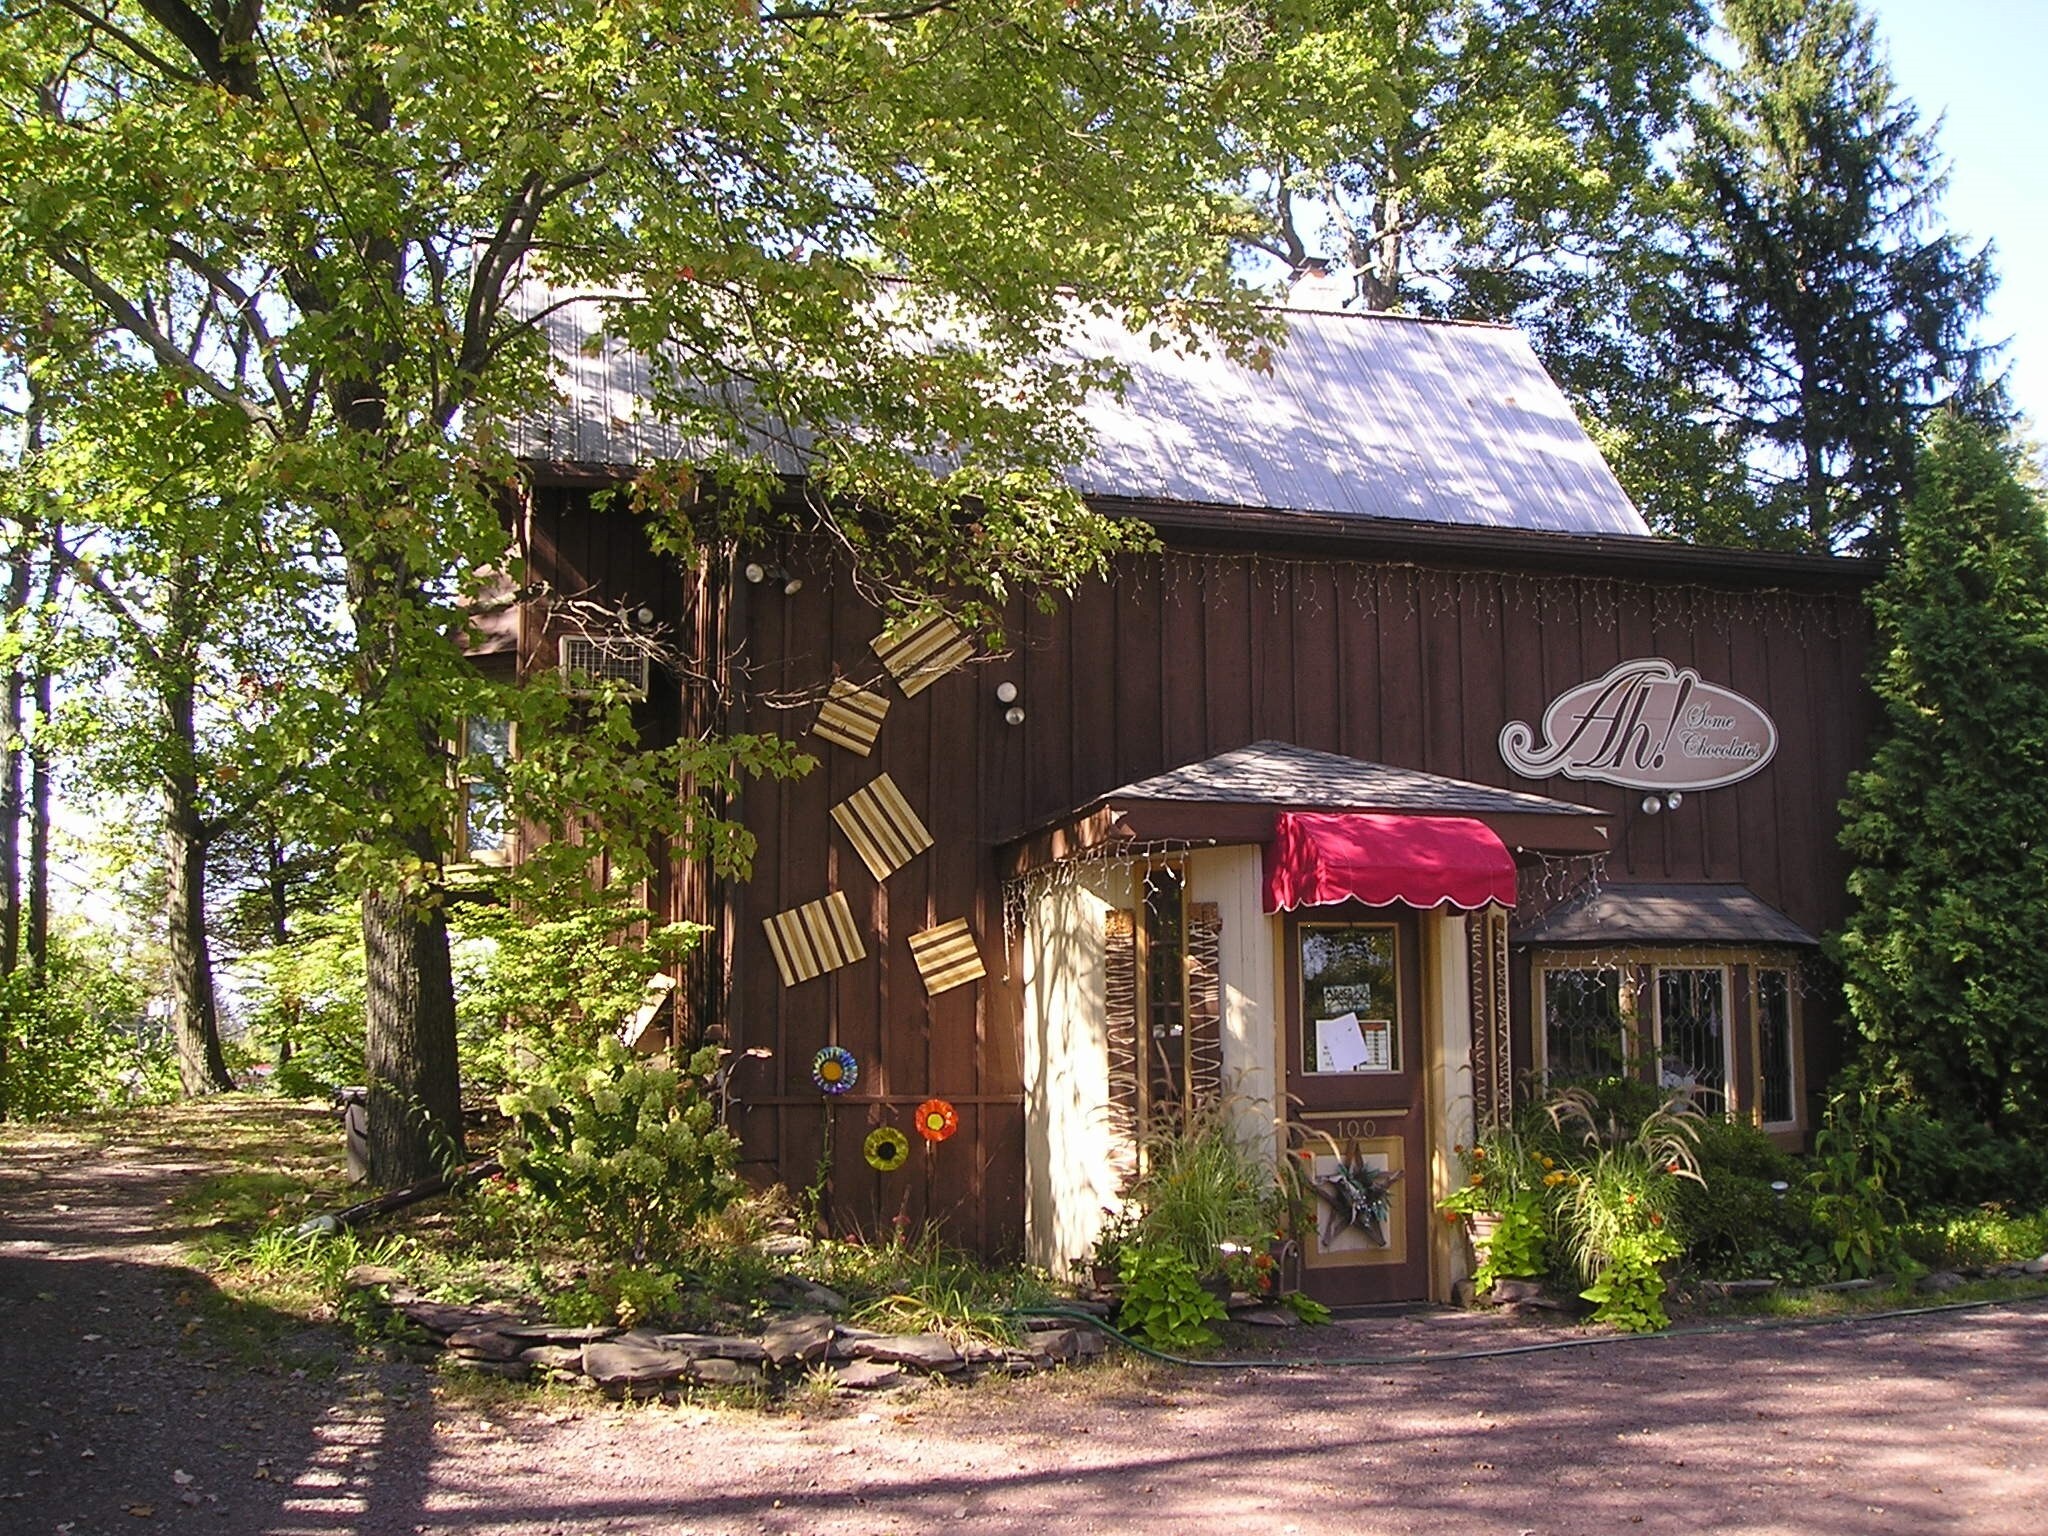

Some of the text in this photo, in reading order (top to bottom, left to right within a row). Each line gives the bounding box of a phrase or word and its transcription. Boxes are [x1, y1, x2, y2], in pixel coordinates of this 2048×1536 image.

[1512, 671, 1692, 770] Ah!
[1688, 704, 1734, 730] Some
[1681, 732, 1760, 759] Chocolates
[1336, 1119, 1376, 1138] 100
